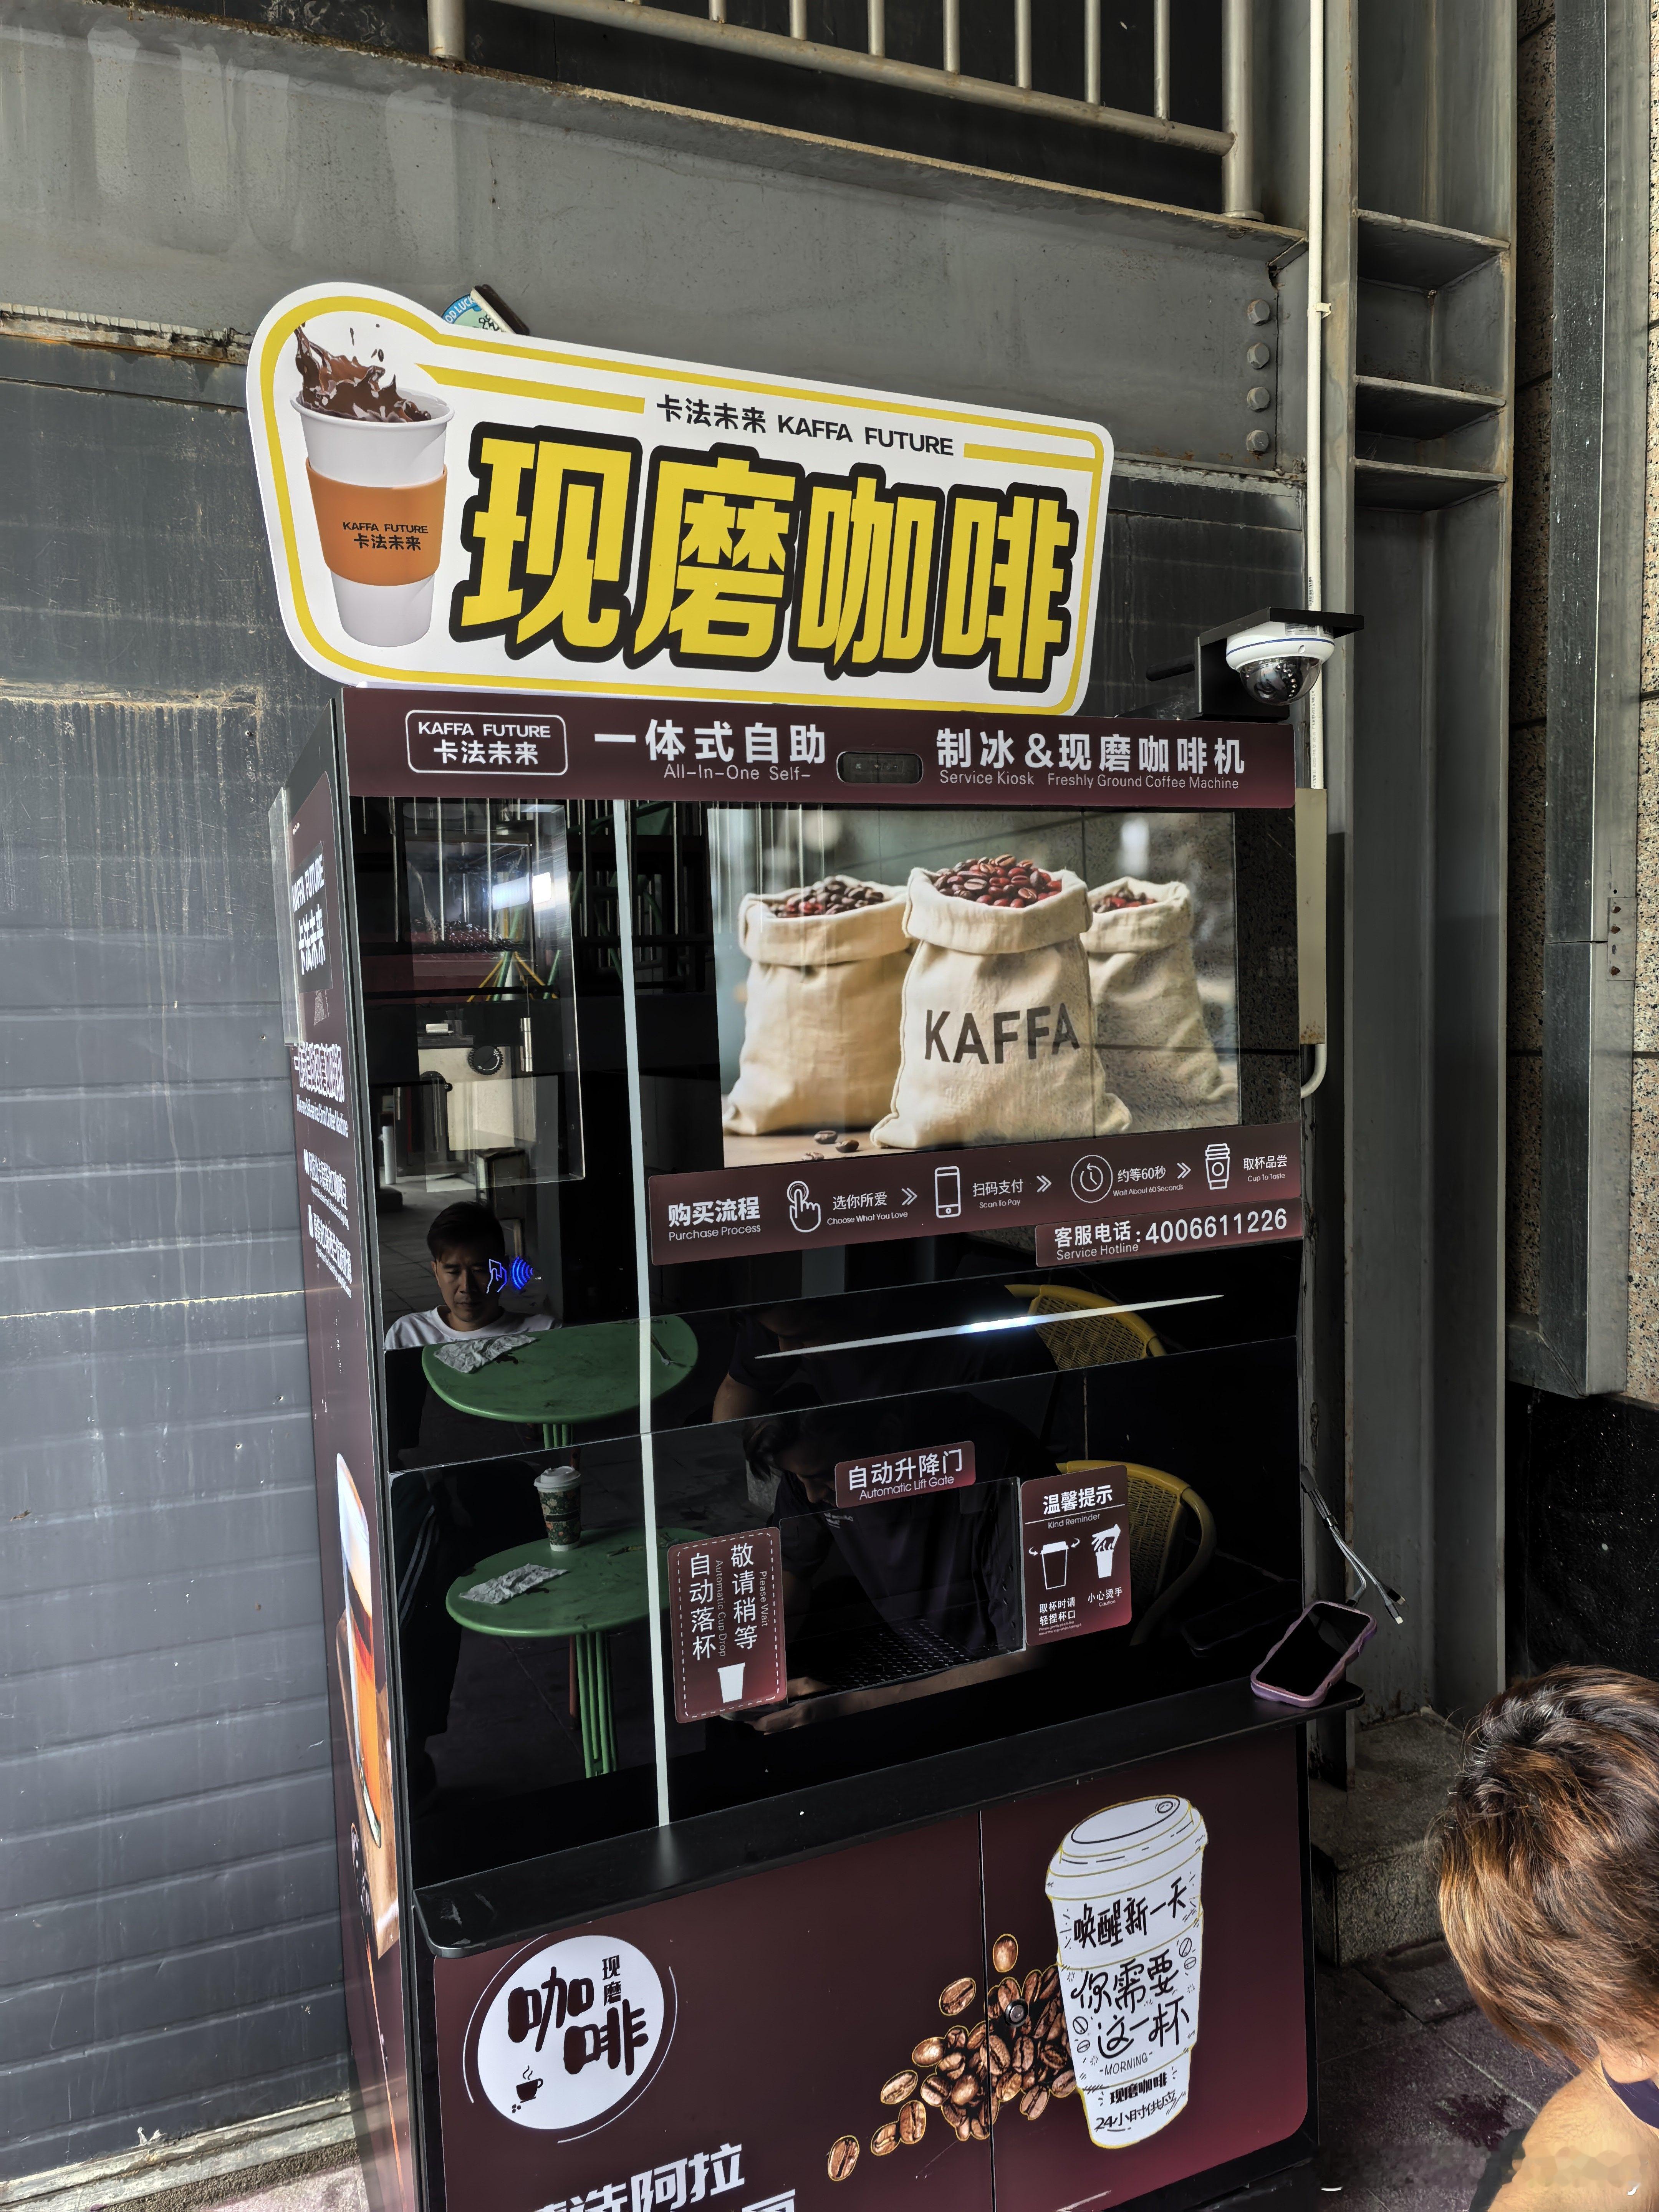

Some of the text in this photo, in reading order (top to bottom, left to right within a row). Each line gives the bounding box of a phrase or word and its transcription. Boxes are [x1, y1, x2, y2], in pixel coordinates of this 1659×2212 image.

[656, 394, 767, 433] 卡法未来
[777, 414, 954, 456] KAFFA FUTURE
[343, 521, 429, 534] KAFFA FUTURE
[353, 533, 421, 551] 卡法未来
[457, 432, 1075, 685] 现磨咖啡
[418, 721, 551, 738] KAFFA FUTURE
[433, 738, 538, 765] 卡法未来
[594, 719, 1245, 775] 一体式自助 制冰&现磨咖啡机
[664, 763, 1239, 790] All-In-One Self- Service Kiosk Freshly Ground Coffee Machine
[291, 853, 325, 913] KAFFA FUTURE
[298, 903, 326, 975] 卡法未来
[924, 1002, 1080, 1065] KAFFA
[1117, 1165, 1166, 1182] 约等60秒
[1243, 1154, 1287, 1171] 取杯品尝
[832, 1191, 888, 1212] 选你所爱
[972, 1179, 1024, 1197] 扫码支付
[1157, 1184, 1184, 1192] Seconds
[667, 1196, 761, 1228] 购买流程
[827, 1217, 855, 1225] Choose
[856, 1214, 876, 1222] What
[669, 1224, 761, 1241] Purchase Process
[1056, 1242, 1139, 1260] Service Hotline
[849, 1449, 962, 1491] 自动升降门
[859, 1475, 954, 1500] Automatic Lift Gate
[1043, 1484, 1113, 1515] 温馨提示
[1048, 1513, 1101, 1529] Kind Reminder
[689, 1552, 717, 1661] 自动落杯
[715, 1560, 727, 1657] Automatic Cup Drop
[730, 1542, 758, 1650] 敬请稍等
[759, 1571, 769, 1627] Please Wait
[1039, 1596, 1075, 1614] 取杯时请
[1087, 1586, 1123, 1603] 小心烫手
[1039, 1609, 1076, 1626] 轻捏杯口
[1073, 1877, 1187, 1949] 唤醒新一天
[601, 1954, 622, 2007] 现磨
[1070, 1949, 1179, 2014] 你需要
[507, 1966, 649, 2076] 咖啡
[1098, 1995, 1190, 2059] 这一杯
[1110, 2072, 1168, 2105] 现磨咖啡
[1094, 2089, 1177, 2132] 24小时供应
[536, 2142, 746, 2212] 选阿拉
